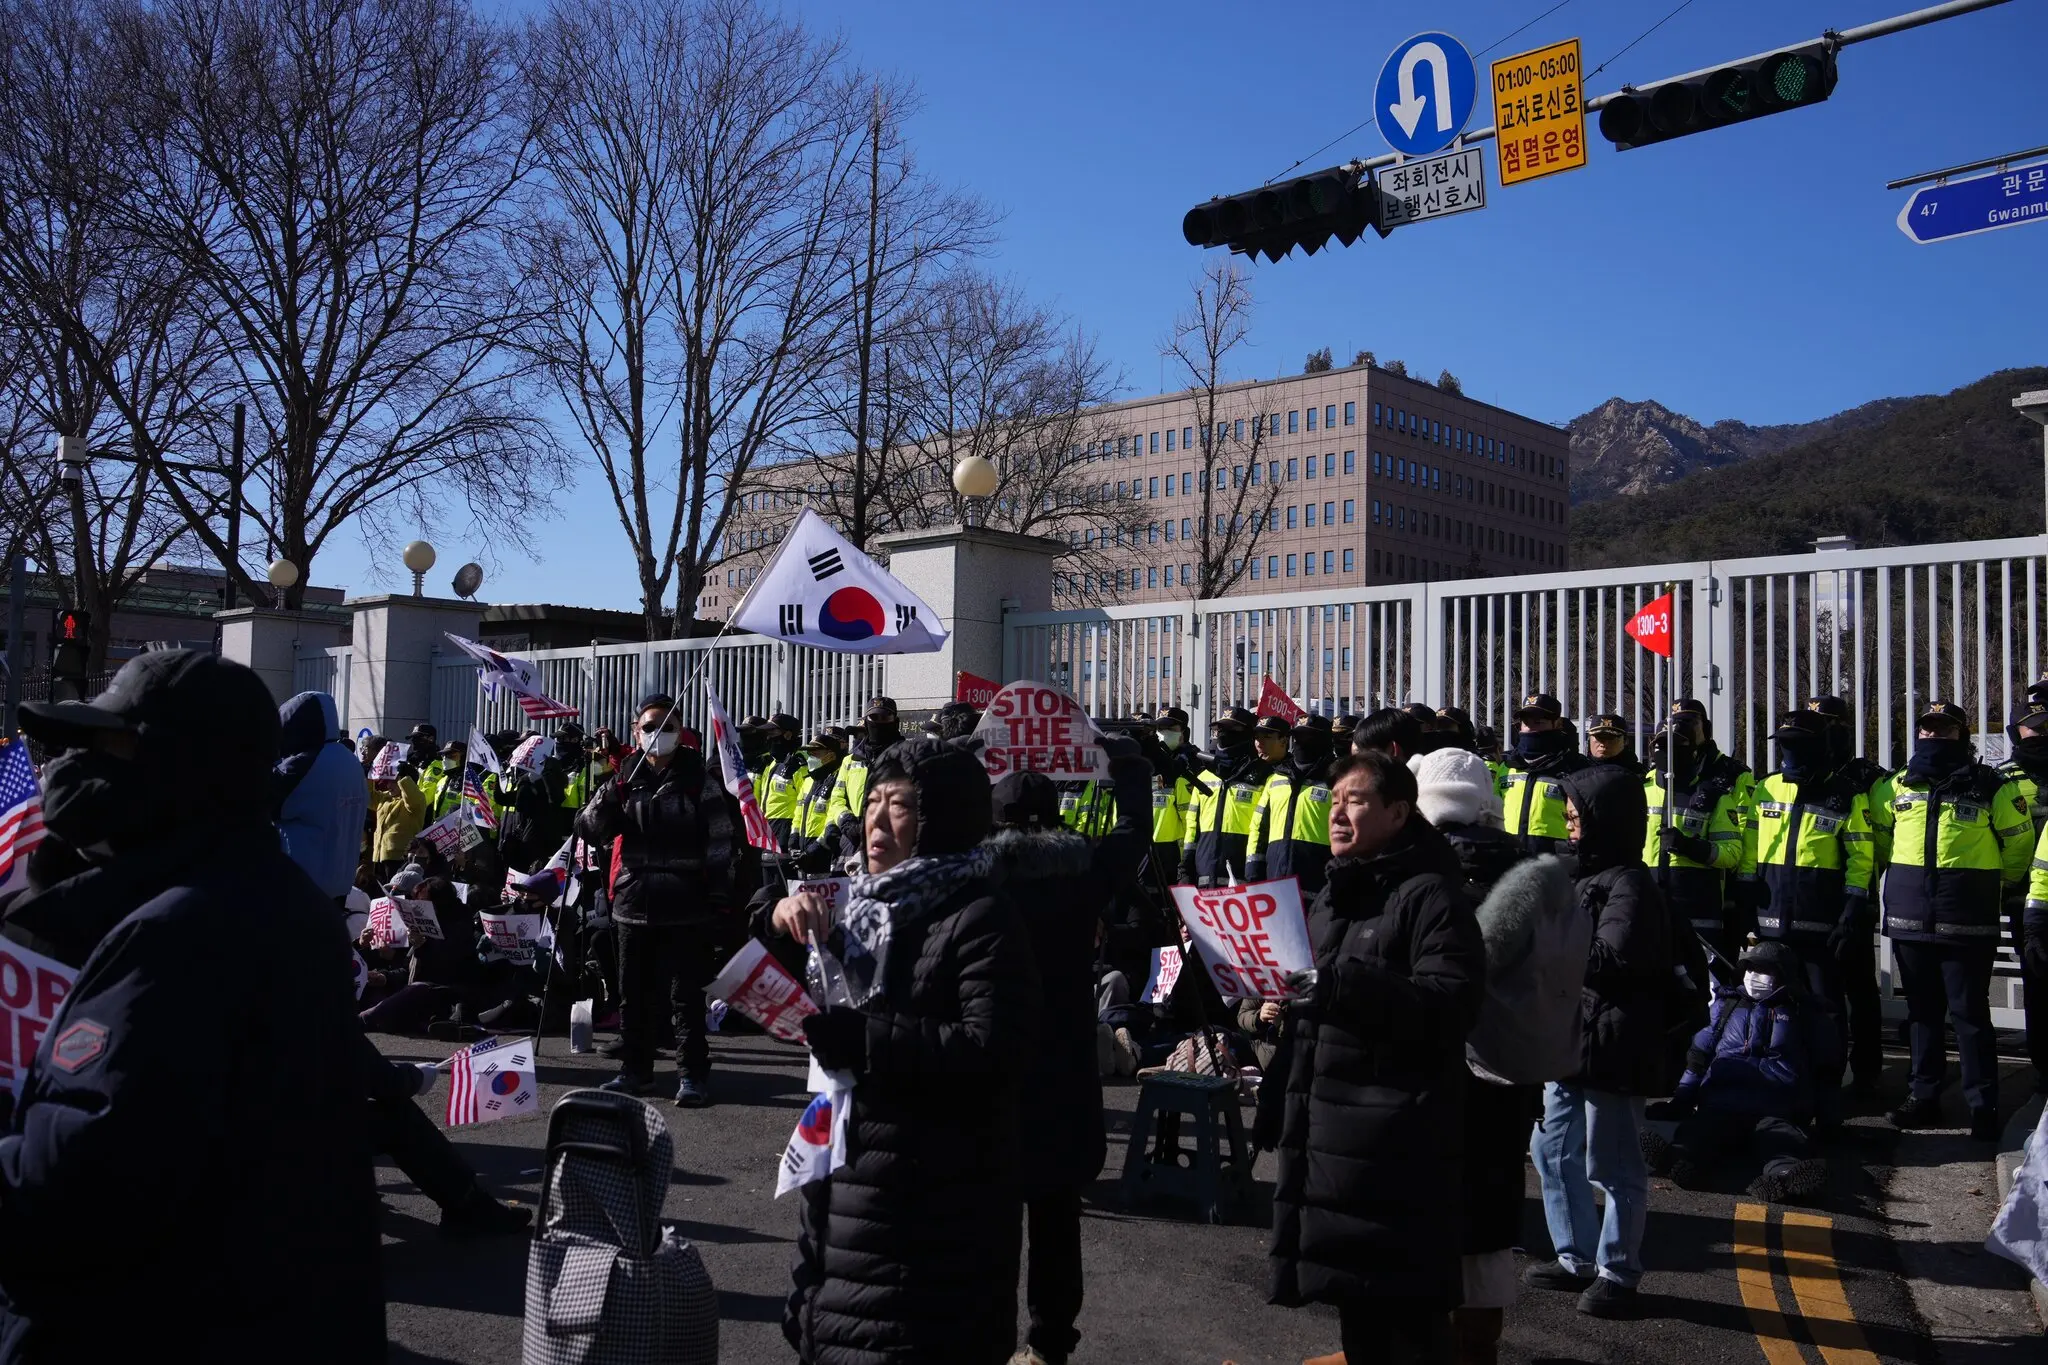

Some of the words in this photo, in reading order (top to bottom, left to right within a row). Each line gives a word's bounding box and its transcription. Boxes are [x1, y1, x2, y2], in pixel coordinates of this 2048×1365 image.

[1498, 53, 1575, 92] 01:00~05:00
[1501, 84, 1578, 130] 교차로신호
[1503, 124, 1580, 174] 점멸운영
[1393, 155, 1468, 192] 좌회전시
[1385, 180, 1481, 220] 보행신호시
[1921, 202, 1938, 216] 47
[1637, 612, 1668, 636] 1300-3
[1004, 718, 1072, 746] THE
[984, 746, 1095, 775] STEAL
[1193, 893, 1277, 932] STOP
[1214, 930, 1279, 967] THE
[1162, 966, 1179, 983] THE
[1212, 963, 1301, 997] STEA
